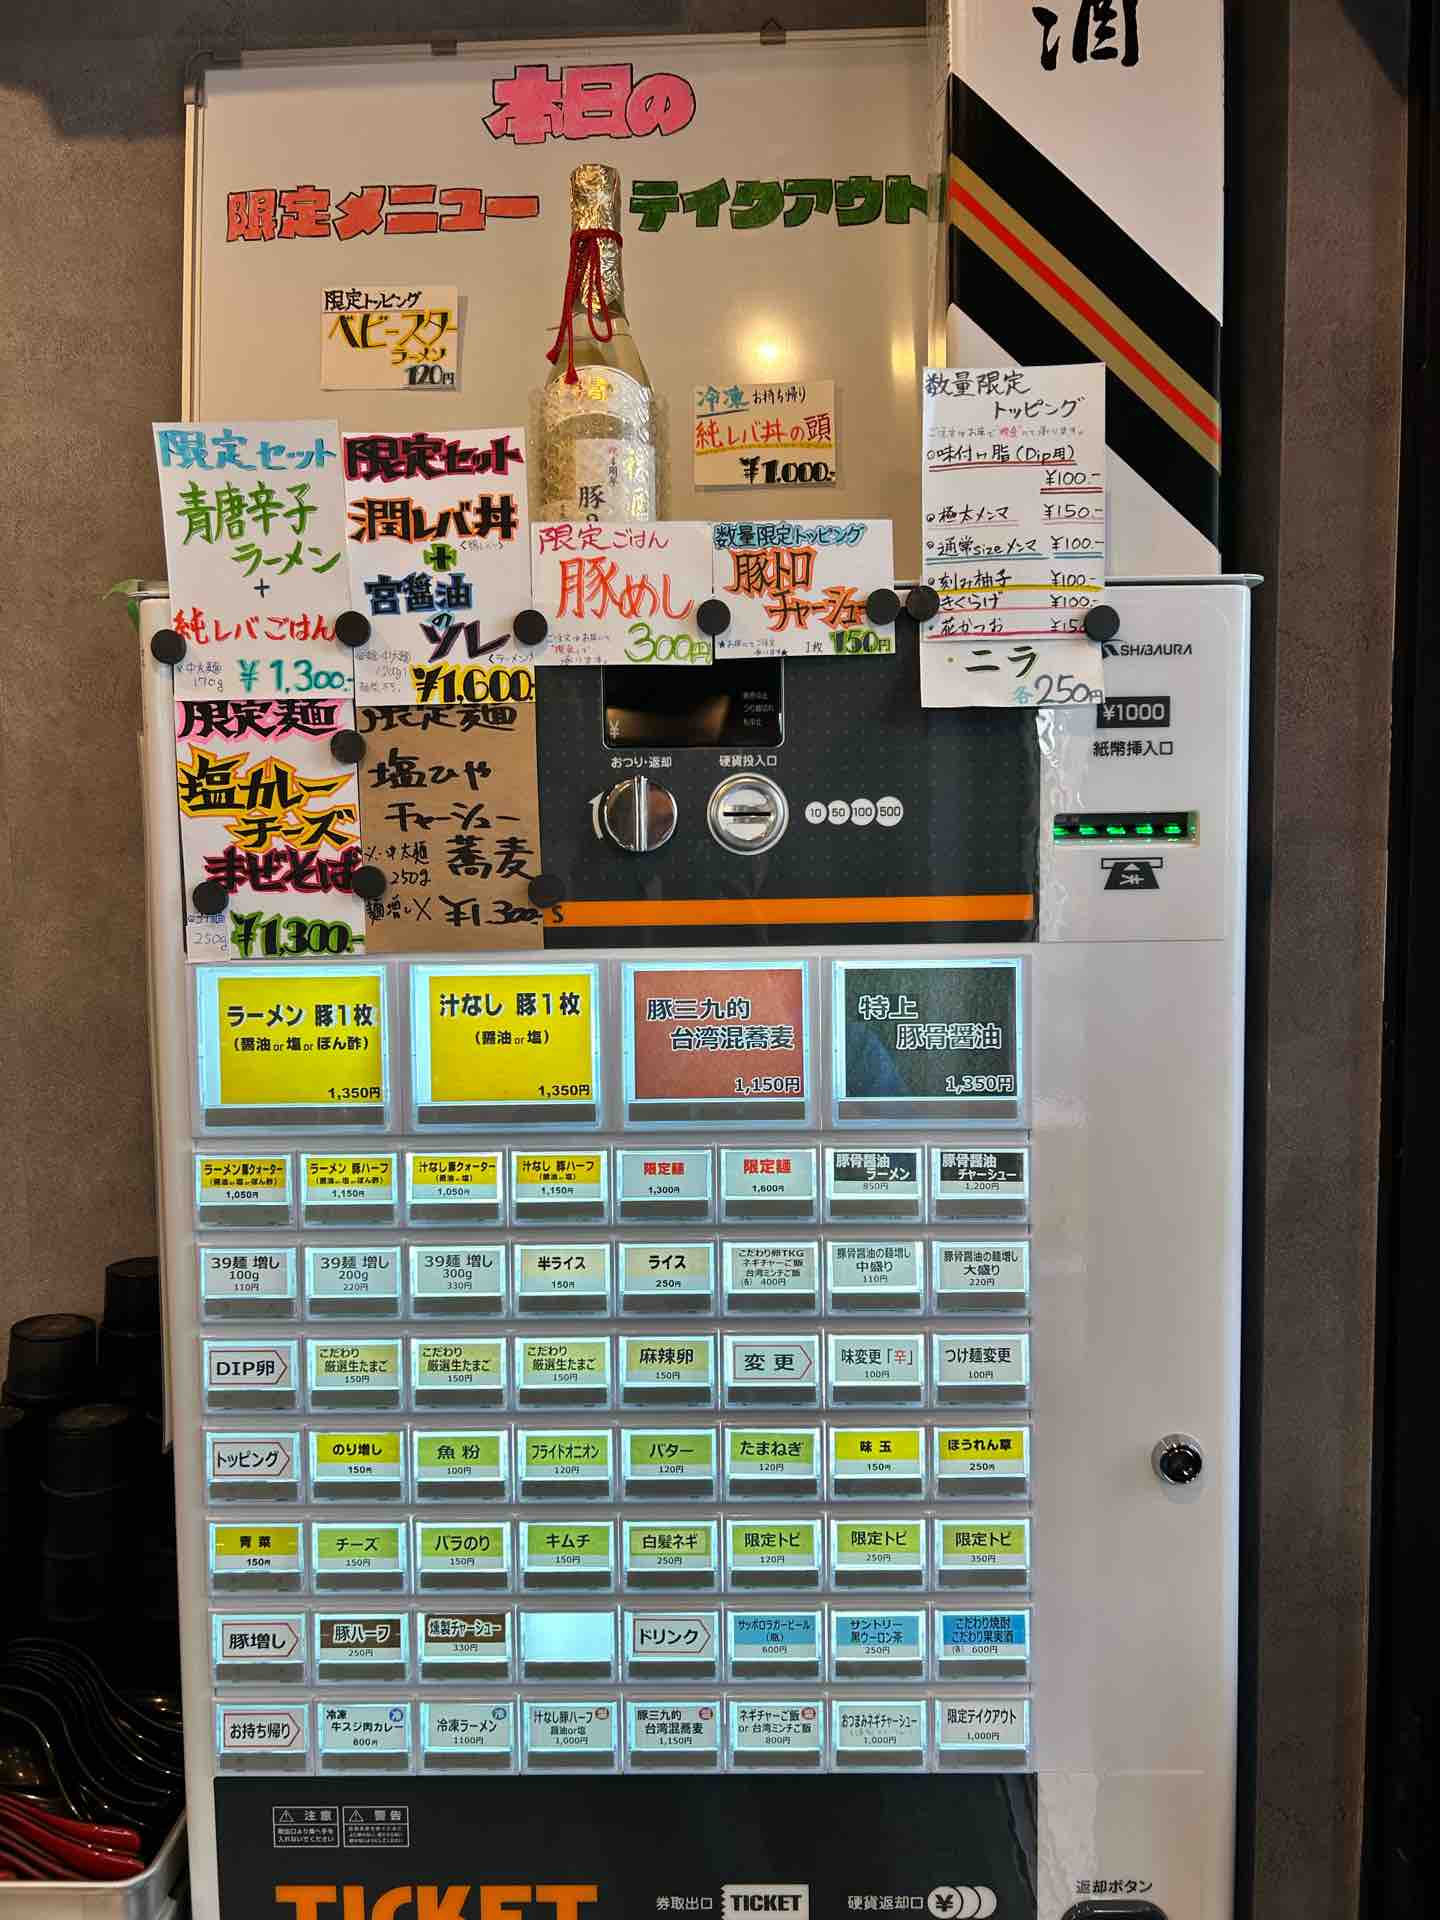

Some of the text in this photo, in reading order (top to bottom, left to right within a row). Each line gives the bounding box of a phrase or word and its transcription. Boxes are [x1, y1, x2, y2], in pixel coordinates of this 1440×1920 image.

[482, 63, 696, 144] 本日の
[629, 175, 936, 232] テイクアウト
[225, 184, 540, 242] 限定メニュー
[324, 288, 422, 311] 限定トッピング
[328, 309, 458, 348] ベビースター
[391, 347, 447, 365] ラーメン
[406, 364, 455, 386] 120円
[925, 370, 1032, 398] 数量限定
[697, 384, 807, 410] 冷凍 お持ち帰り
[994, 396, 1087, 420] トッピング
[695, 412, 833, 450] 純レバ丼の頭
[158, 428, 338, 472] 限定セット
[343, 432, 526, 483] 限定セット
[176, 481, 319, 545] 青唐辛子
[347, 493, 519, 544] 潤レバ丼
[539, 523, 670, 555] 限定ごはん
[713, 521, 866, 551] 数量限定トッピング
[231, 540, 342, 578] ラーメン
[724, 546, 817, 595] 豚トロ
[555, 556, 695, 621] 豚めし
[764, 586, 868, 632] チャーシュー
[173, 607, 338, 645] 純レバごはん
[624, 622, 714, 666] 300円
[829, 629, 893, 654] 150円
[1120, 643, 1193, 657] SHIBAURA
[965, 645, 1039, 679] ニラ
[1034, 673, 1104, 705] 250円
[177, 700, 338, 742] 限定麺
[1103, 703, 1165, 721] ¥1000
[1093, 741, 1174, 757] 紙幣挿入口
[368, 748, 494, 791] 塩ひや
[719, 755, 777, 768] 硬貨投入口
[178, 750, 348, 814] 塩カレー
[384, 801, 521, 834] チャーシュー
[228, 807, 358, 850] チーズ
[439, 992, 581, 1017] 汁なし 豚1枚
[647, 995, 751, 1021] 豚三九的
[858, 995, 919, 1020] 特上
[226, 1004, 374, 1027] ラーメン 豚1枚
[670, 1025, 795, 1051] 台湾混蕎麦
[896, 1024, 1003, 1051] 豚骨醤油
[538, 1084, 591, 1098] 1,350円
[735, 1076, 800, 1094] 1,150円
[946, 1075, 1015, 1093] 1,350円
[328, 1087, 381, 1100] 1,350円
[743, 1158, 793, 1174] 限定麺
[866, 1168, 911, 1181] ラーメン
[957, 1168, 1017, 1181] チャーシュー
[226, 1190, 259, 1200] 1,050円
[537, 1255, 587, 1271] 半ライス
[648, 1255, 687, 1270] ライス
[856, 1260, 894, 1273] 中盛り
[963, 1264, 1001, 1277] 大盛り
[229, 1270, 260, 1282] 100g
[339, 1270, 369, 1282] 200g
[442, 1269, 473, 1280] 300g
[320, 1348, 360, 1359] こだわり
[422, 1346, 463, 1357] こだわり
[527, 1345, 568, 1356] こだわり
[945, 1347, 1012, 1364] つけ麺変更
[216, 1360, 275, 1376] DIP卵
[744, 1353, 795, 1372] 変更
[332, 1442, 384, 1456] のり増し
[531, 1444, 600, 1460] フライドオニオン
[649, 1443, 695, 1459] バター
[739, 1440, 805, 1457] たまねぎ
[947, 1438, 1012, 1452] ほうれん草
[216, 1450, 280, 1469] トッピング
[335, 1536, 381, 1552] チーズ
[435, 1535, 490, 1551] バラのり
[545, 1533, 591, 1549] キムチ
[642, 1532, 699, 1550] 白髪ネギ
[247, 1558, 271, 1567] 150円
[333, 1624, 391, 1643] 豚ハーフ
[851, 1619, 903, 1630] サントリー
[229, 1632, 286, 1649] 豚増し
[639, 1628, 698, 1645] ドリンク
[437, 1718, 497, 1733] 冷凍ラーメン
[947, 1708, 1017, 1725] 限定テイクアウト
[230, 1722, 291, 1740] お持ち帰り
[1075, 1879, 1153, 1895] 返却ボタン
[655, 1896, 713, 1910] 券取出口
[730, 1894, 802, 1912] TICKET
[848, 1895, 924, 1910] 硬貨返却口
